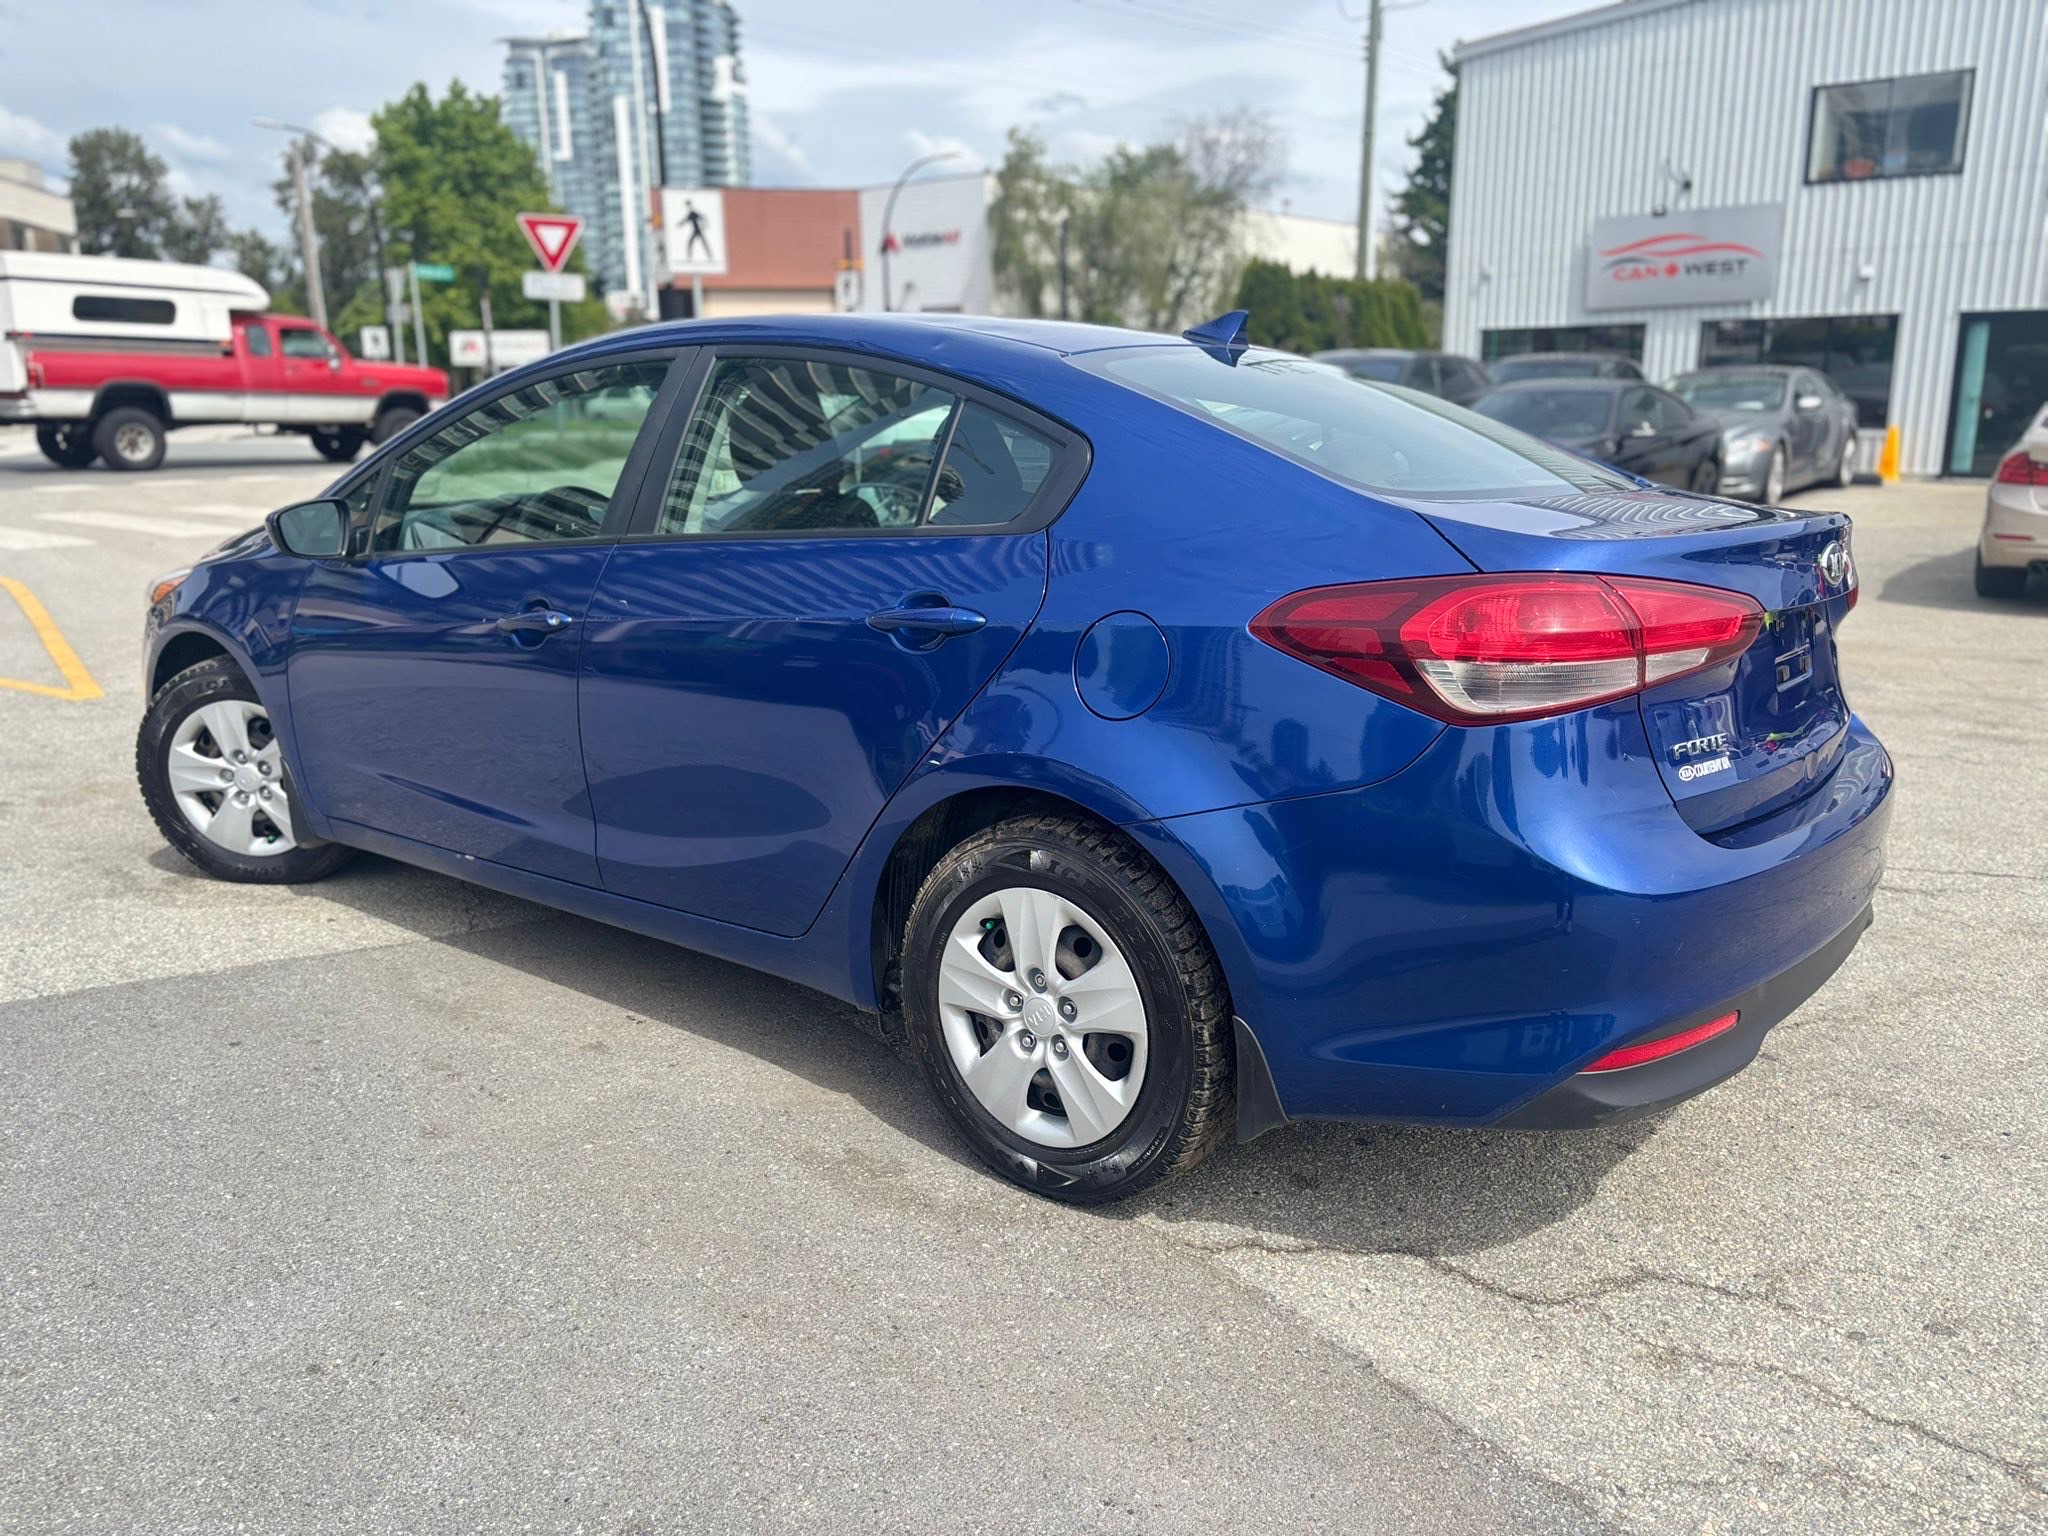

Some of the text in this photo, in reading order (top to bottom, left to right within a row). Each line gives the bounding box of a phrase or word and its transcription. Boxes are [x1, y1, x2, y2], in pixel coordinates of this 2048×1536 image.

[1612, 258, 1749, 283] CAN WEST
[1670, 732, 1730, 761] FORTE
[1680, 767, 1694, 780] KIA
